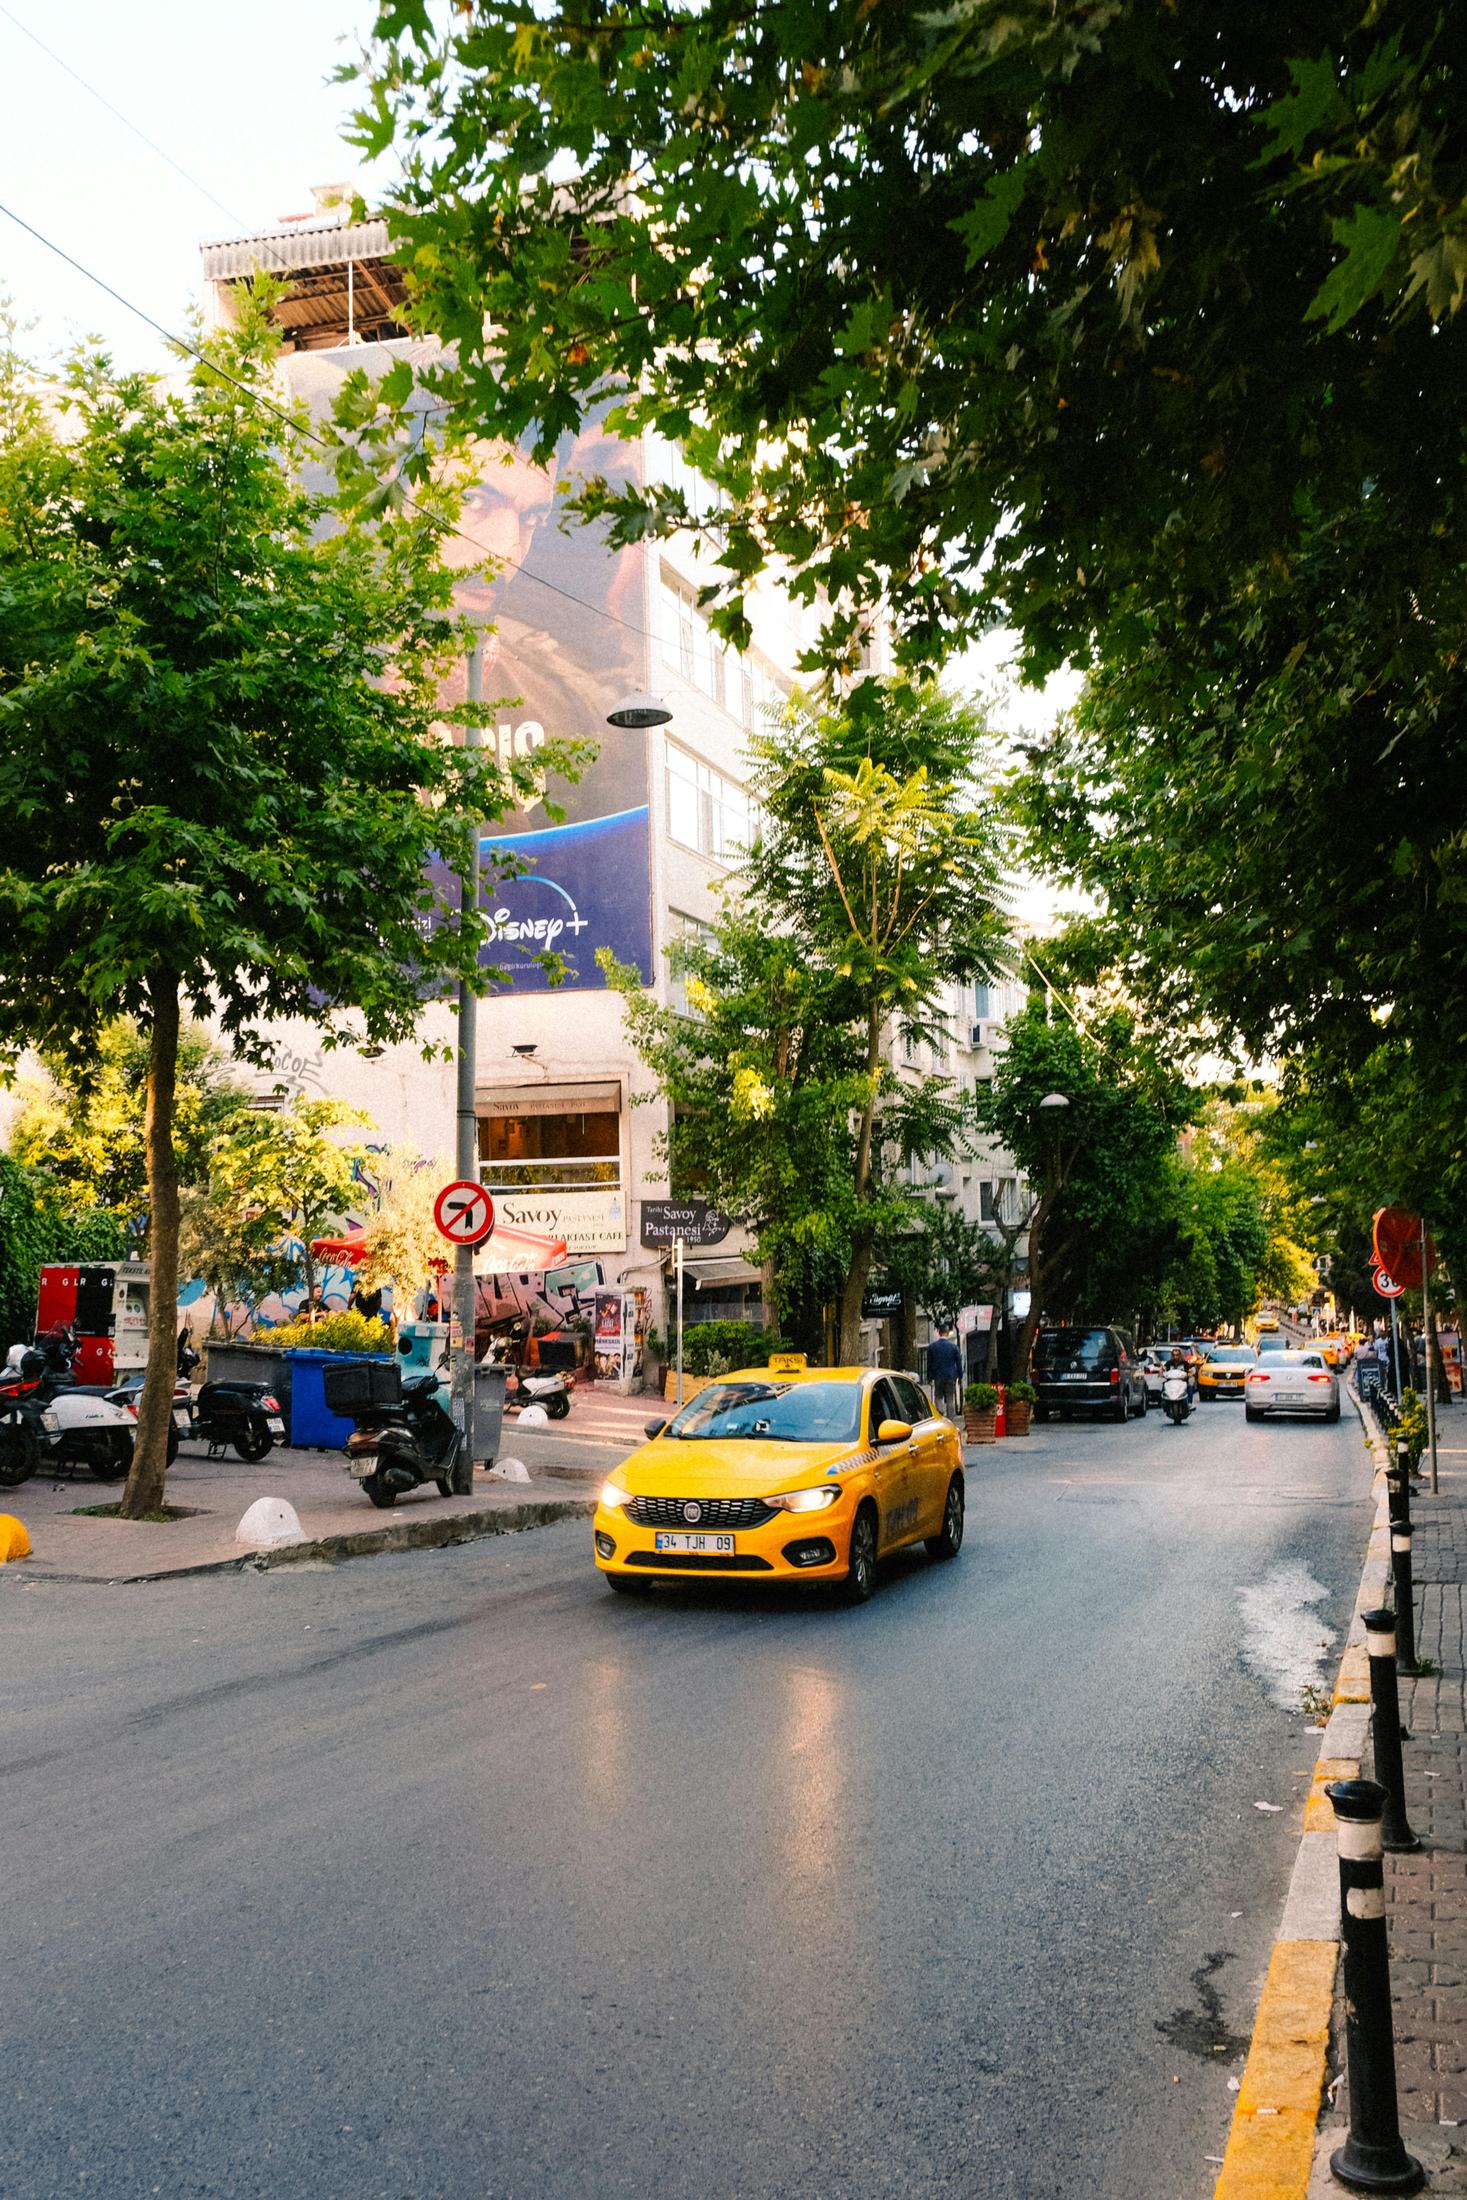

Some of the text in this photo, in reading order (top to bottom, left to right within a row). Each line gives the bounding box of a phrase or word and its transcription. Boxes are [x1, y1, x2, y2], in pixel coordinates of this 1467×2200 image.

[503, 1202, 562, 1231] Savoy
[663, 1206, 697, 1225] Savoy
[645, 1222, 701, 1236] Pastanesi
[663, 1535, 731, 1551] 34 TJH 09
